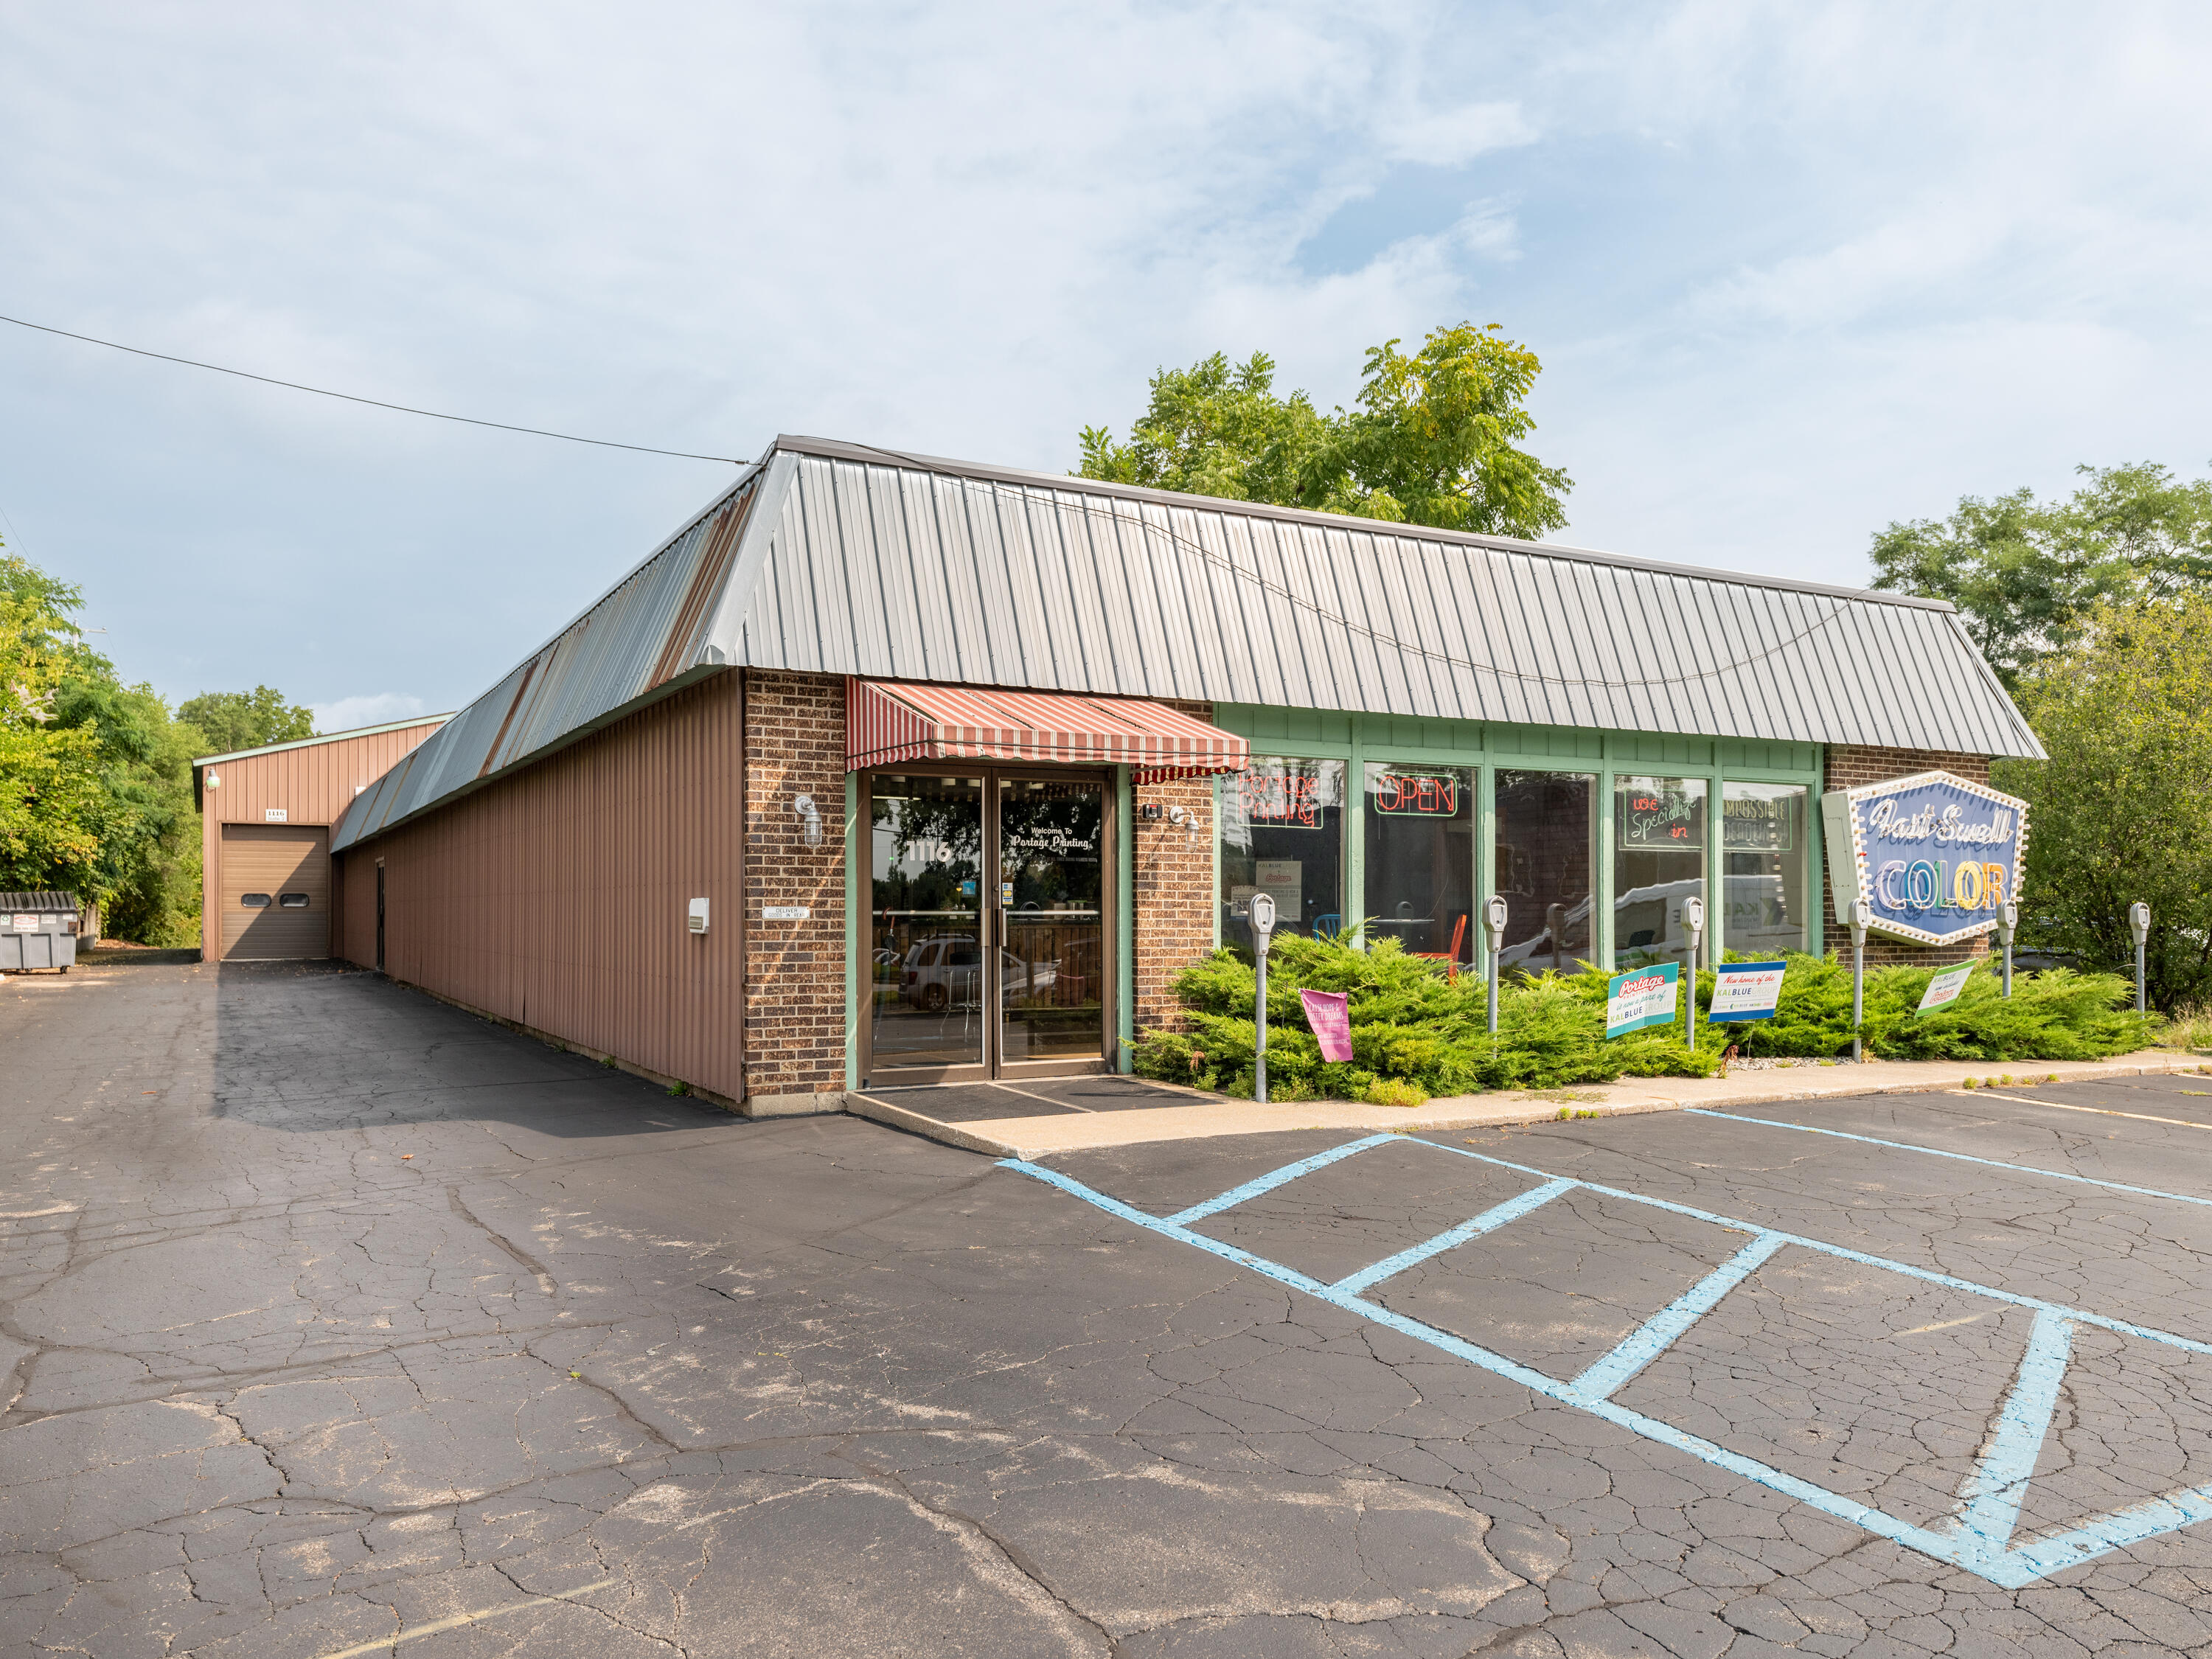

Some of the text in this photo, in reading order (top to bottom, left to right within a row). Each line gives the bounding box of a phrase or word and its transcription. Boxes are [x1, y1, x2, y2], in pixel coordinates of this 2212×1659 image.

[1239, 767, 1318, 801] Portage
[1379, 776, 1453, 811] OPEN
[1239, 792, 1315, 827] Printing
[1631, 794, 1696, 840] Specialize
[1722, 799, 1784, 819] IMPOSSIBLE
[1672, 823, 1688, 838] in
[906, 841, 951, 862] 1116
[1013, 835, 1089, 850] Portage Printing
[1875, 860, 2008, 910] COLOR
[1618, 975, 1665, 998] Portage
[1723, 973, 1775, 985] New home of the
[1325, 1012, 1343, 1020] DREAMS
